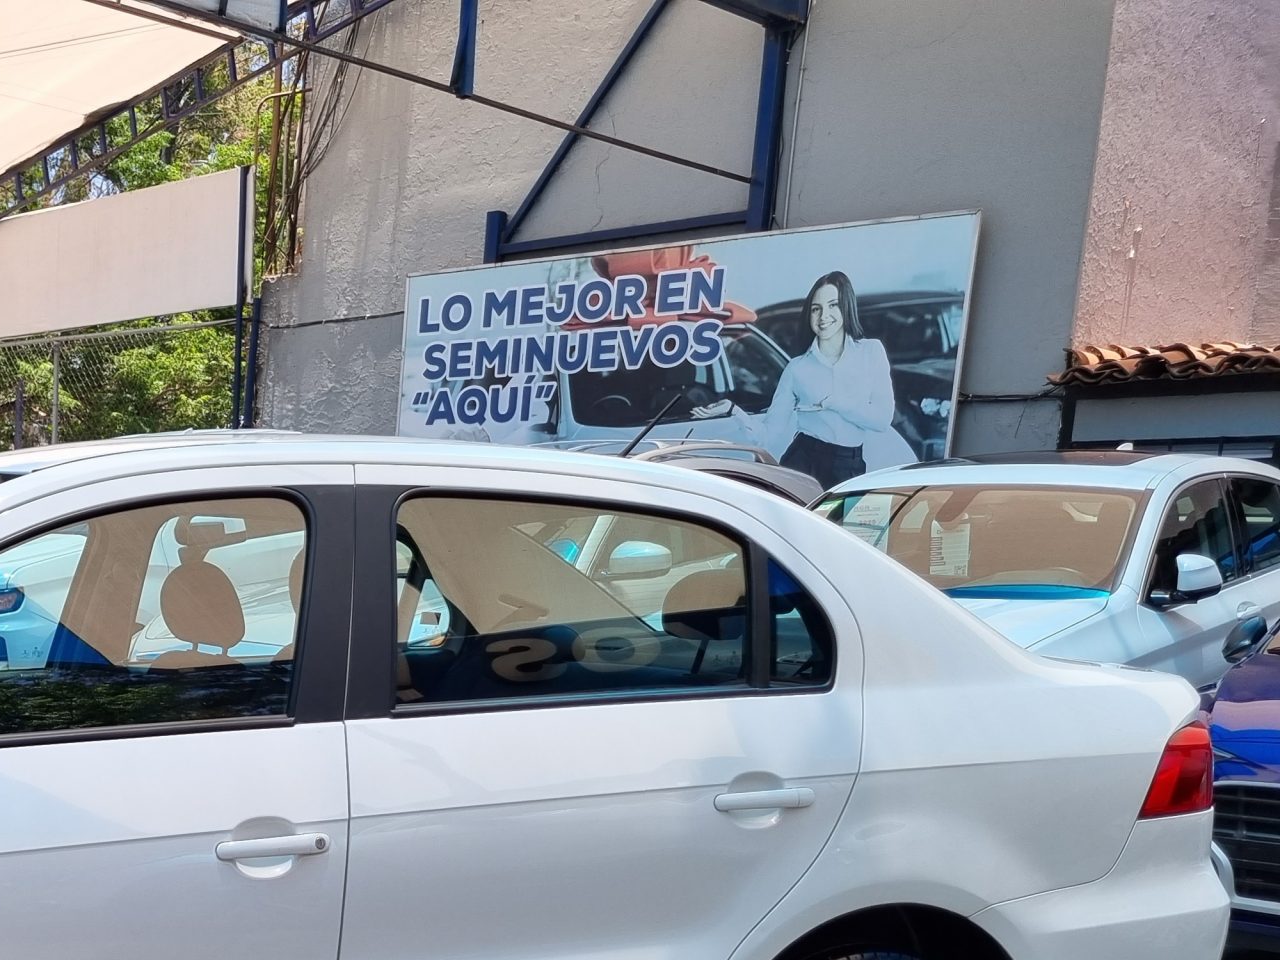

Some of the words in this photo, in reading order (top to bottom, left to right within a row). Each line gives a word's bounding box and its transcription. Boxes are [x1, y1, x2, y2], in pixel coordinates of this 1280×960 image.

[419, 294, 473, 333] LO
[482, 277, 646, 329] MEJOR
[657, 268, 725, 314] EN
[422, 322, 723, 380] SEMINUEVOS
